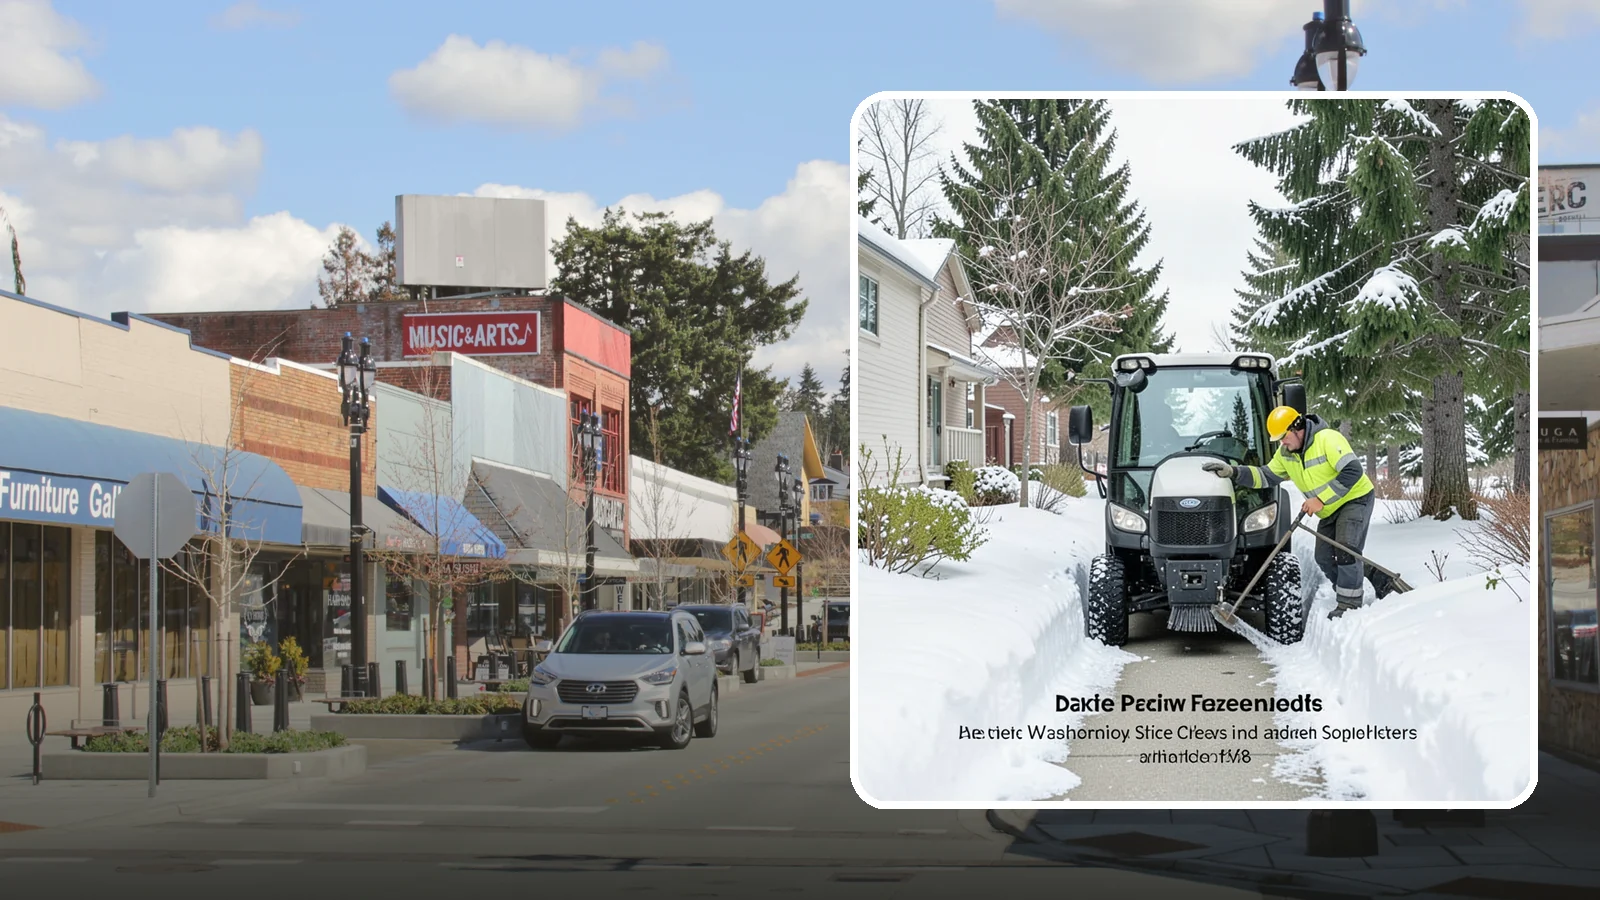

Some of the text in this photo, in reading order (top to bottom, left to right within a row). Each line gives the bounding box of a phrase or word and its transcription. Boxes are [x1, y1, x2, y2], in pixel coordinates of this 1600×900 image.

[1540, 427, 1577, 436] UGA
[0, 471, 121, 519] Furniture Gal
